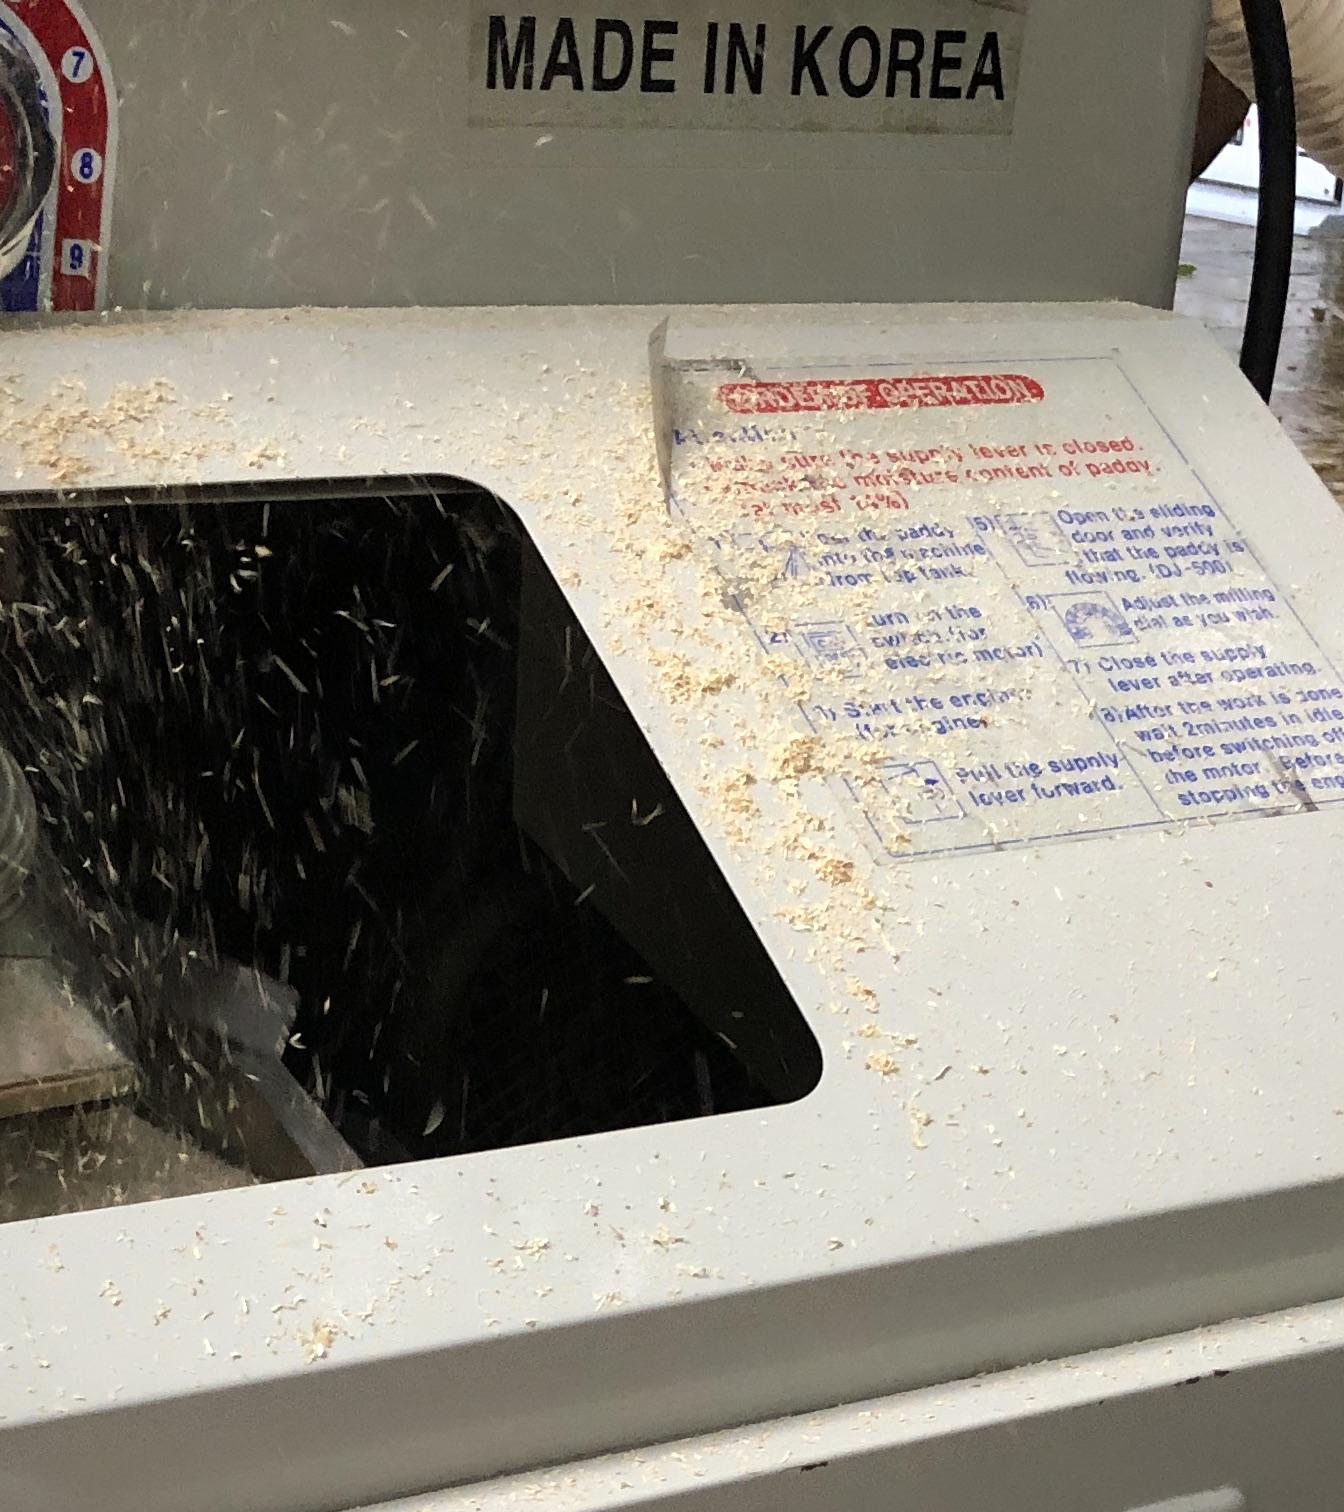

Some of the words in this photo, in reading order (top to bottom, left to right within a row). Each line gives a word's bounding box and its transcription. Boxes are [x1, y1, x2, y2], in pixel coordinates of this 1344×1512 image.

[71, 51, 86, 78] 7
[487, 15, 678, 93] MADE
[704, 22, 767, 95] IN
[790, 25, 1006, 100] KOREA
[78, 151, 94, 179] 8
[69, 243, 84, 271] 9
[1058, 508, 1109, 525] Open
[1071, 528, 1115, 545] door
[1122, 525, 1155, 542] and
[1082, 545, 1124, 564] that
[1128, 543, 1160, 561] the
[1122, 596, 1178, 612] Adjust
[1181, 591, 1209, 606] the
[1198, 611, 1230, 628] you
[1098, 653, 1158, 673] Close
[1160, 649, 1196, 667] the
[1200, 642, 1268, 663] supply
[1107, 675, 1162, 693] lever
[1124, 701, 1174, 722] After
[1177, 699, 1213, 718] the
[1217, 692, 1267, 713] work
[1271, 689, 1292, 705] is
[1282, 709, 1304, 726] in
[1147, 743, 1217, 765] before
[1219, 731, 1320, 756] switching
[1164, 766, 1199, 786] the
